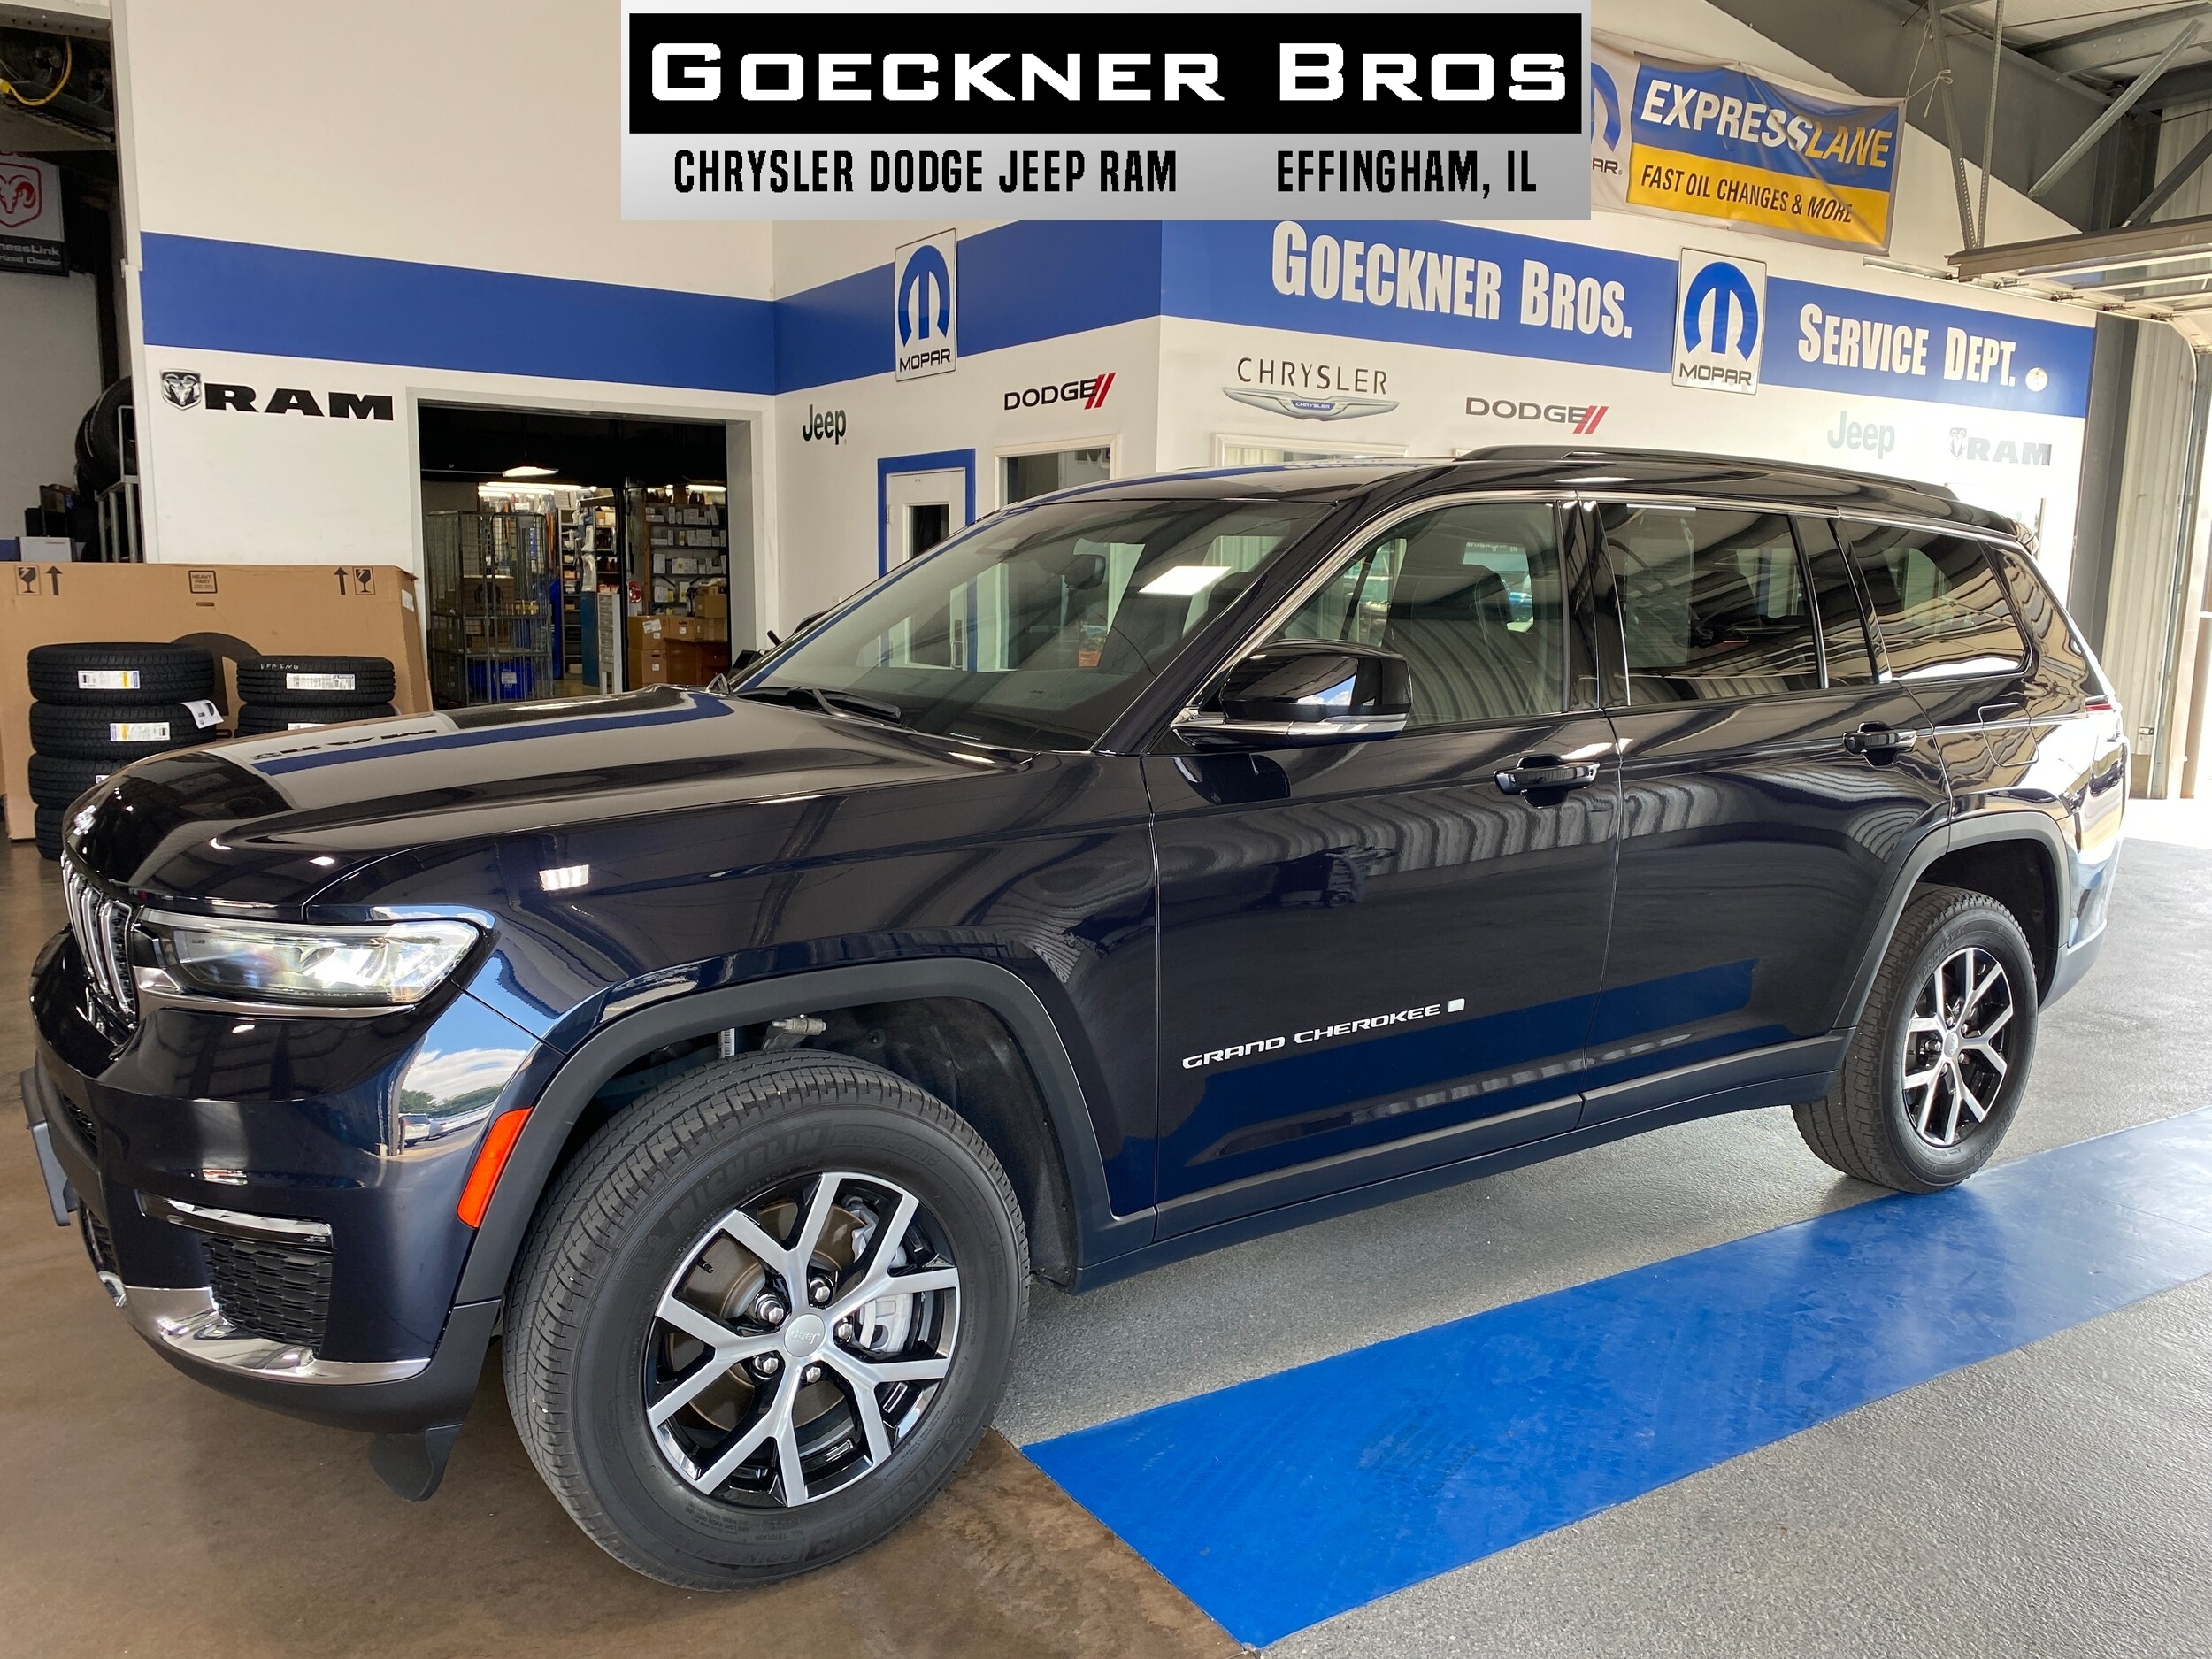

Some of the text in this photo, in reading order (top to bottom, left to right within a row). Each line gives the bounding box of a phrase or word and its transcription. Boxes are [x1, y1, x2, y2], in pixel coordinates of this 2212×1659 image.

[1641, 164, 1853, 224] FAST OIL CHANGES & MORE
[1272, 220, 1632, 339] GOECKNER BROS.
[900, 348, 951, 373] MOPAR
[1798, 303, 2016, 388] SERVICE DEPT.
[1237, 357, 1388, 395] CHRYSLER
[1679, 363, 1752, 386] MOPAR
[204, 383, 394, 421] RAM
[1004, 378, 1098, 411] DODGE
[1465, 396, 1591, 424] DODGE
[803, 404, 846, 445] Jeep
[1827, 411, 1895, 459] Jeep
[1966, 436, 2052, 466] RAM
[1182, 1003, 1441, 1069] GRAND CHEROKEE
